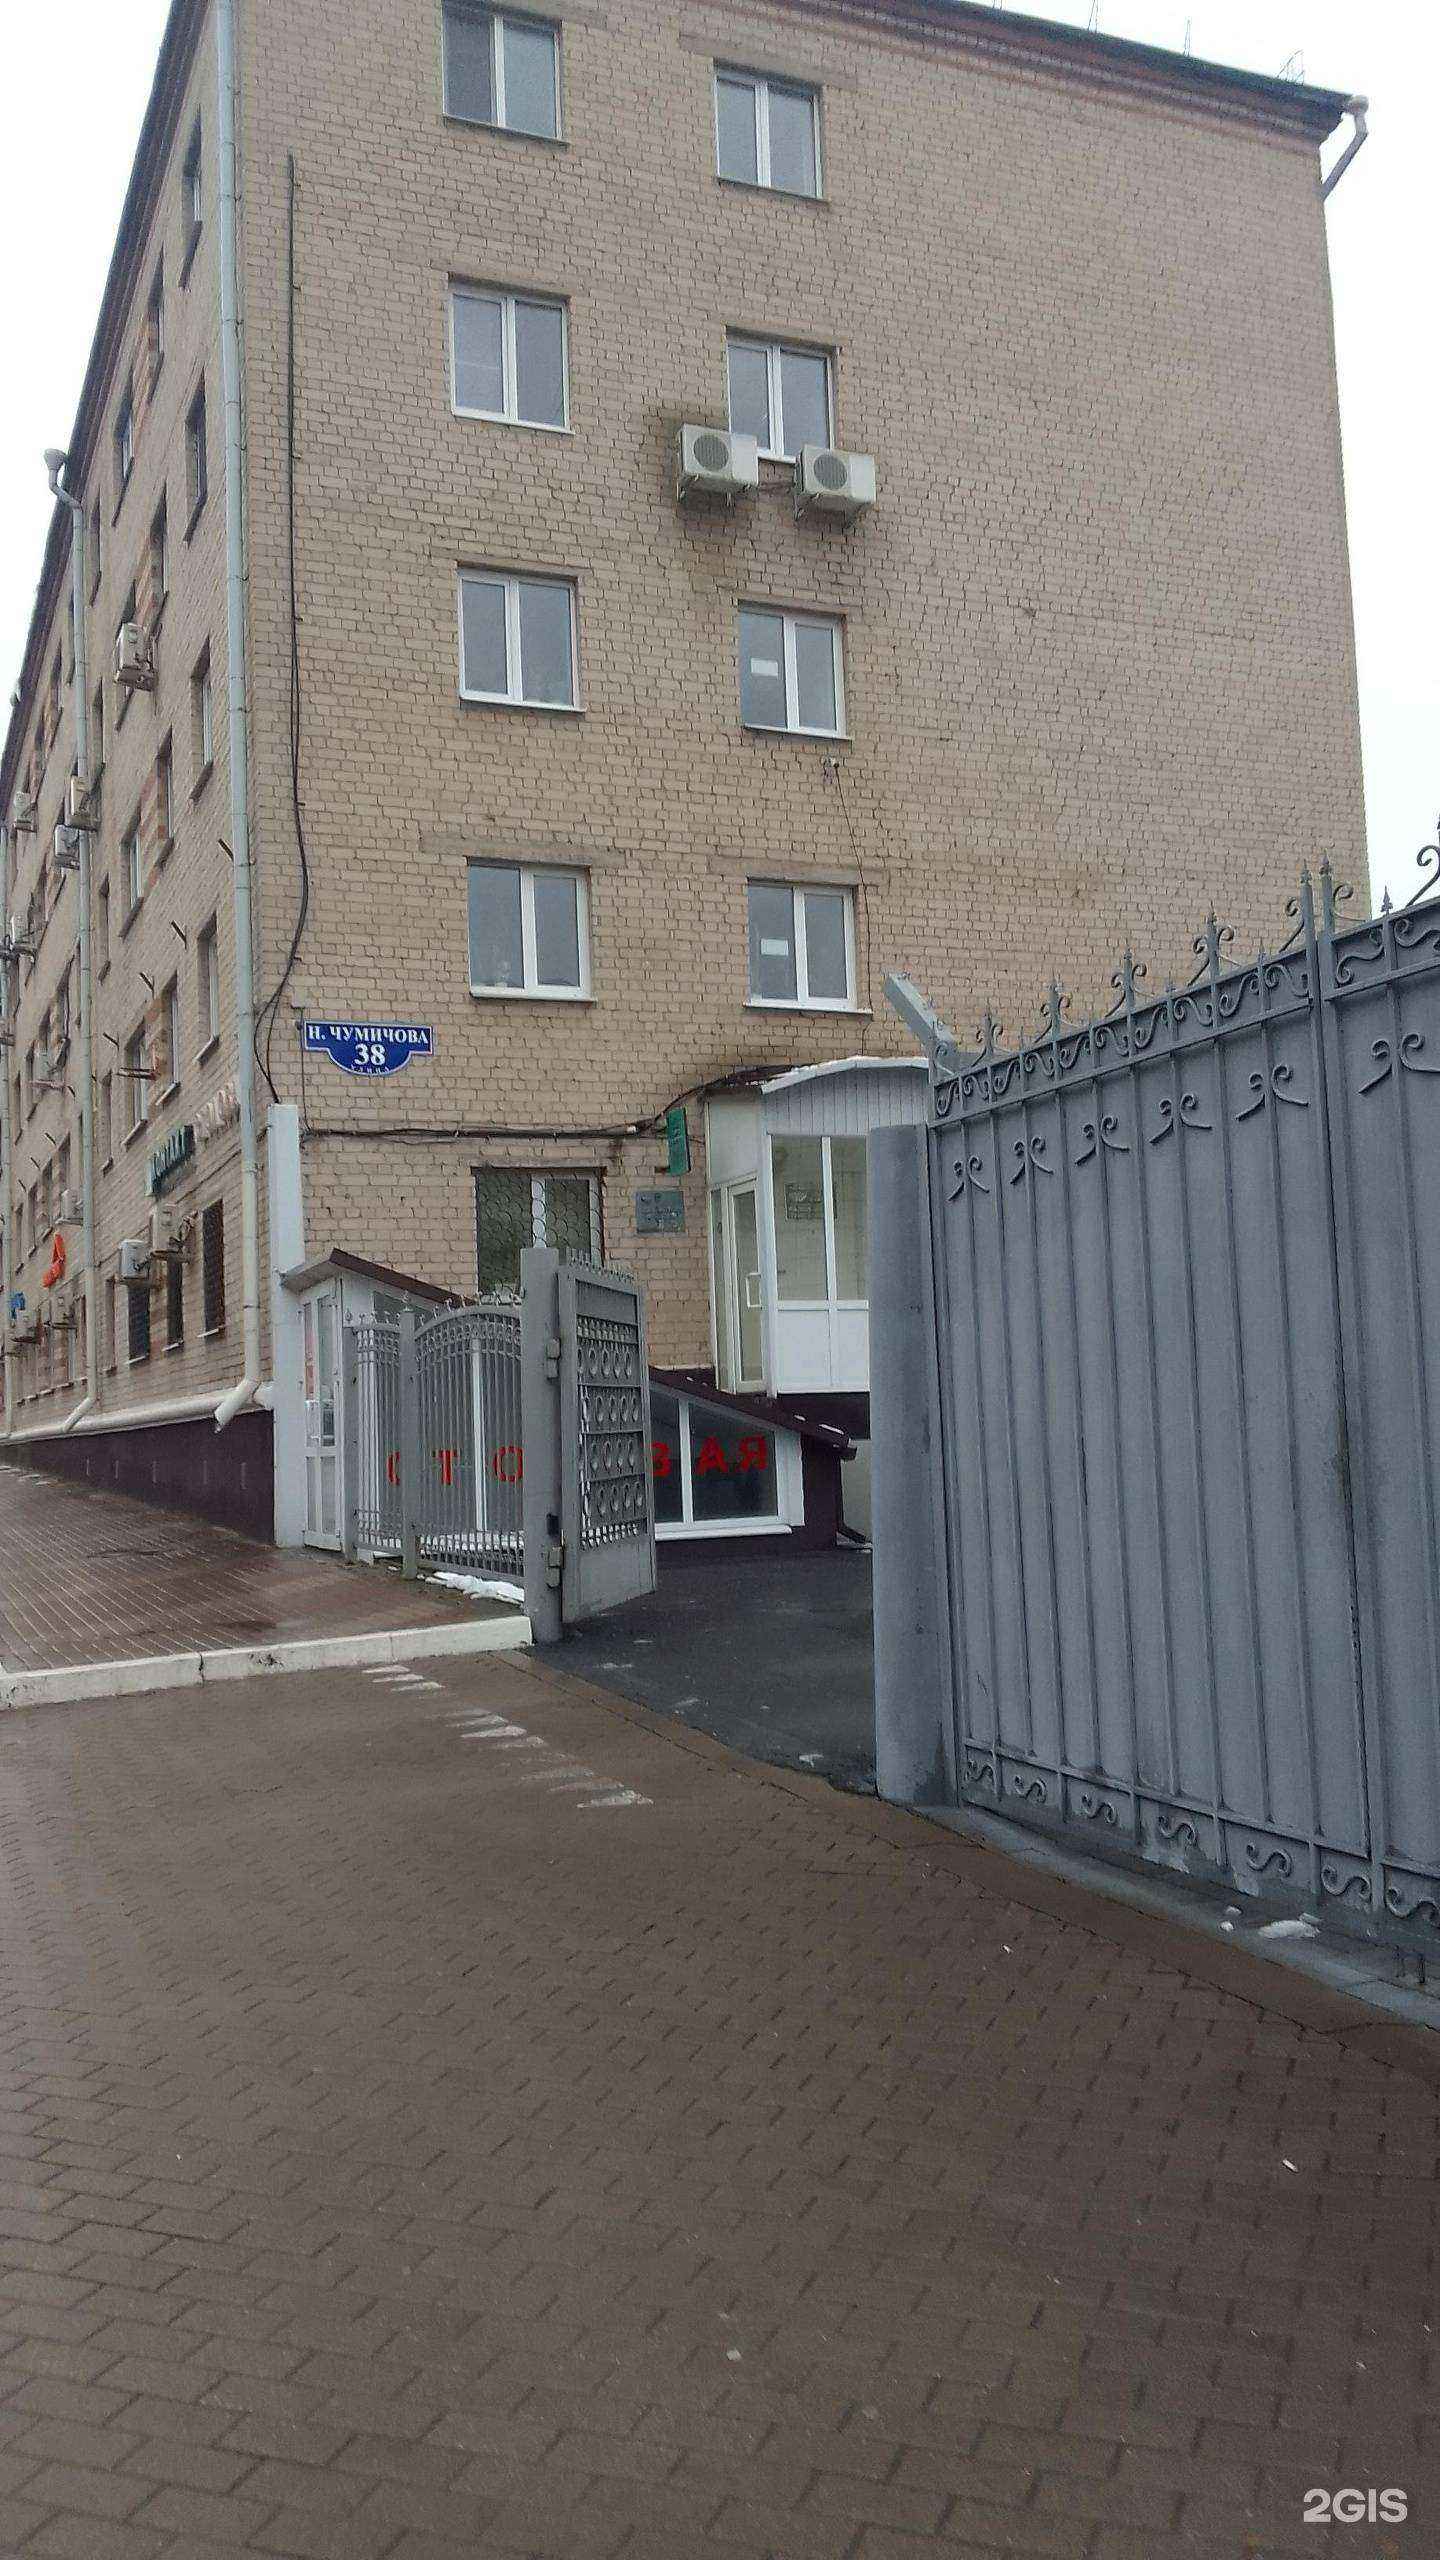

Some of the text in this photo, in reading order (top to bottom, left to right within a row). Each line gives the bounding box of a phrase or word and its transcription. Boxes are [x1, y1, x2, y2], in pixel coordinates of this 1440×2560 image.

[308, 1025, 429, 1044] Н. ЧУМИЧОВА
[354, 1043, 386, 1066] 38
